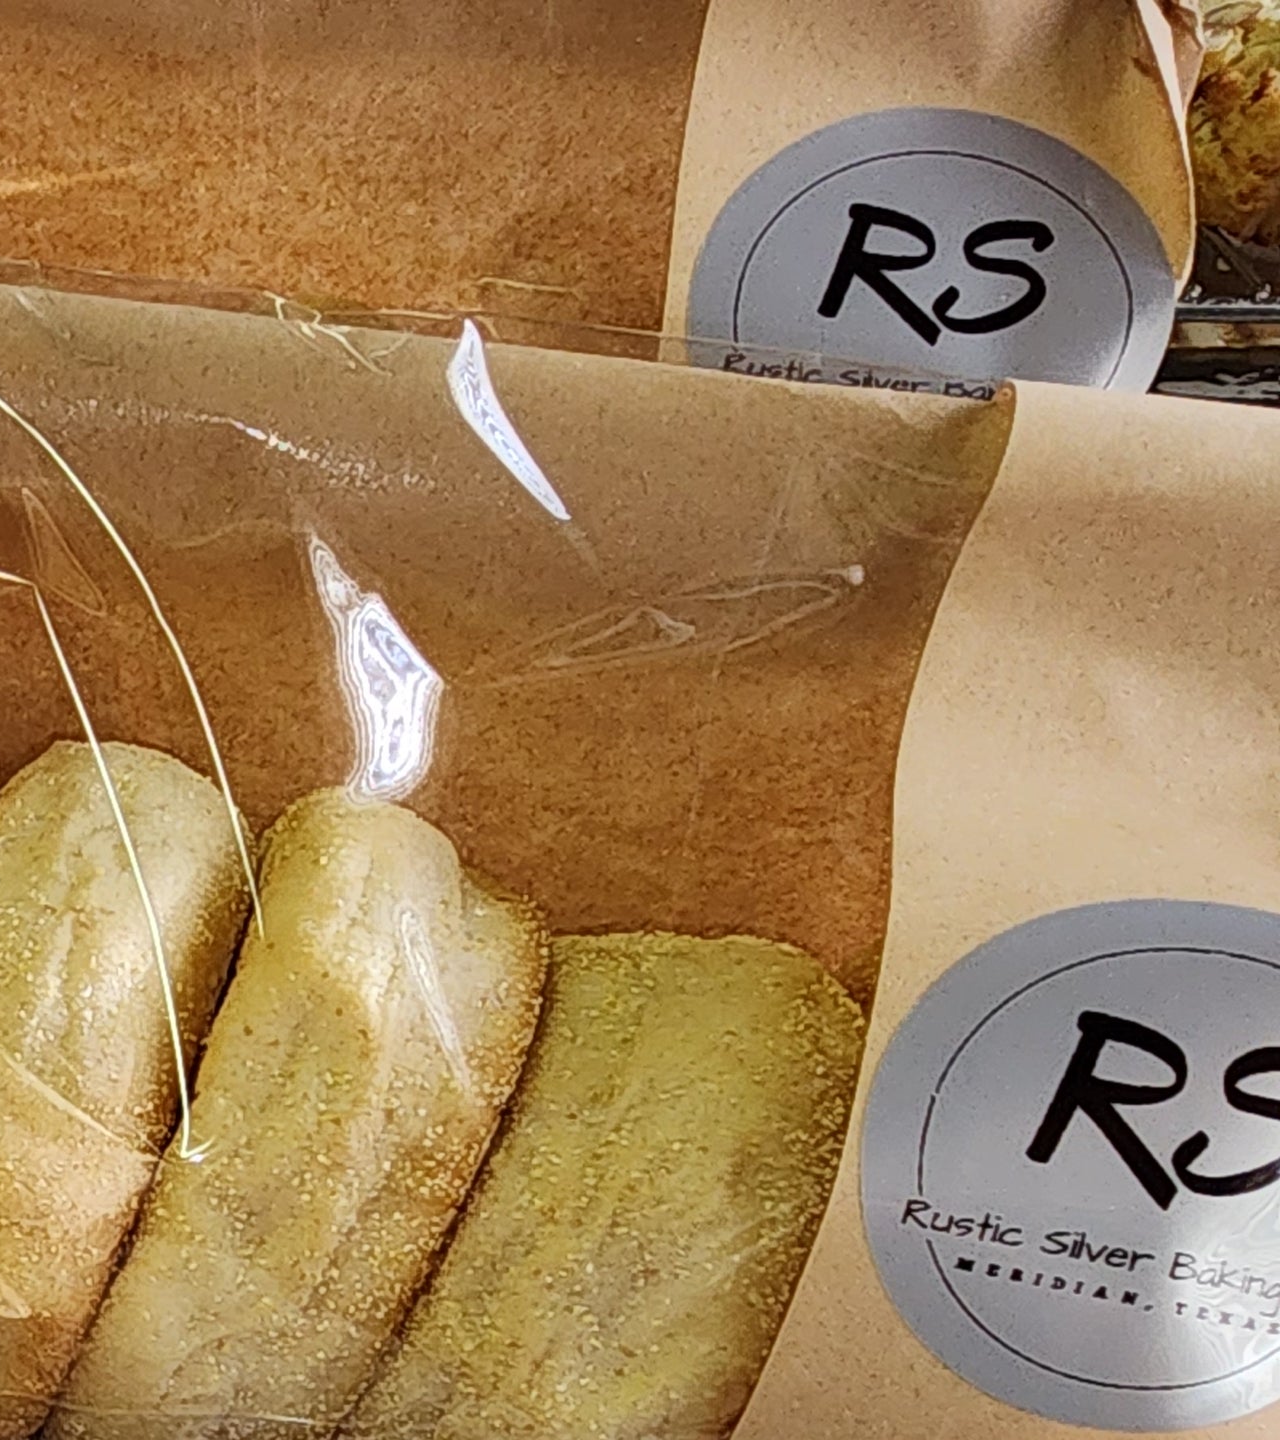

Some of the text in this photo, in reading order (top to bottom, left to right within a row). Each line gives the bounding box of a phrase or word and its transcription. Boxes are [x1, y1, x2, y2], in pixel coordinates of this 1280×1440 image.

[816, 203, 1055, 347] RS
[1025, 1010, 1280, 1212] RS
[900, 1199, 1280, 1317] Rustic Silver Baking
[953, 1257, 1154, 1311] MERIDIAN,
